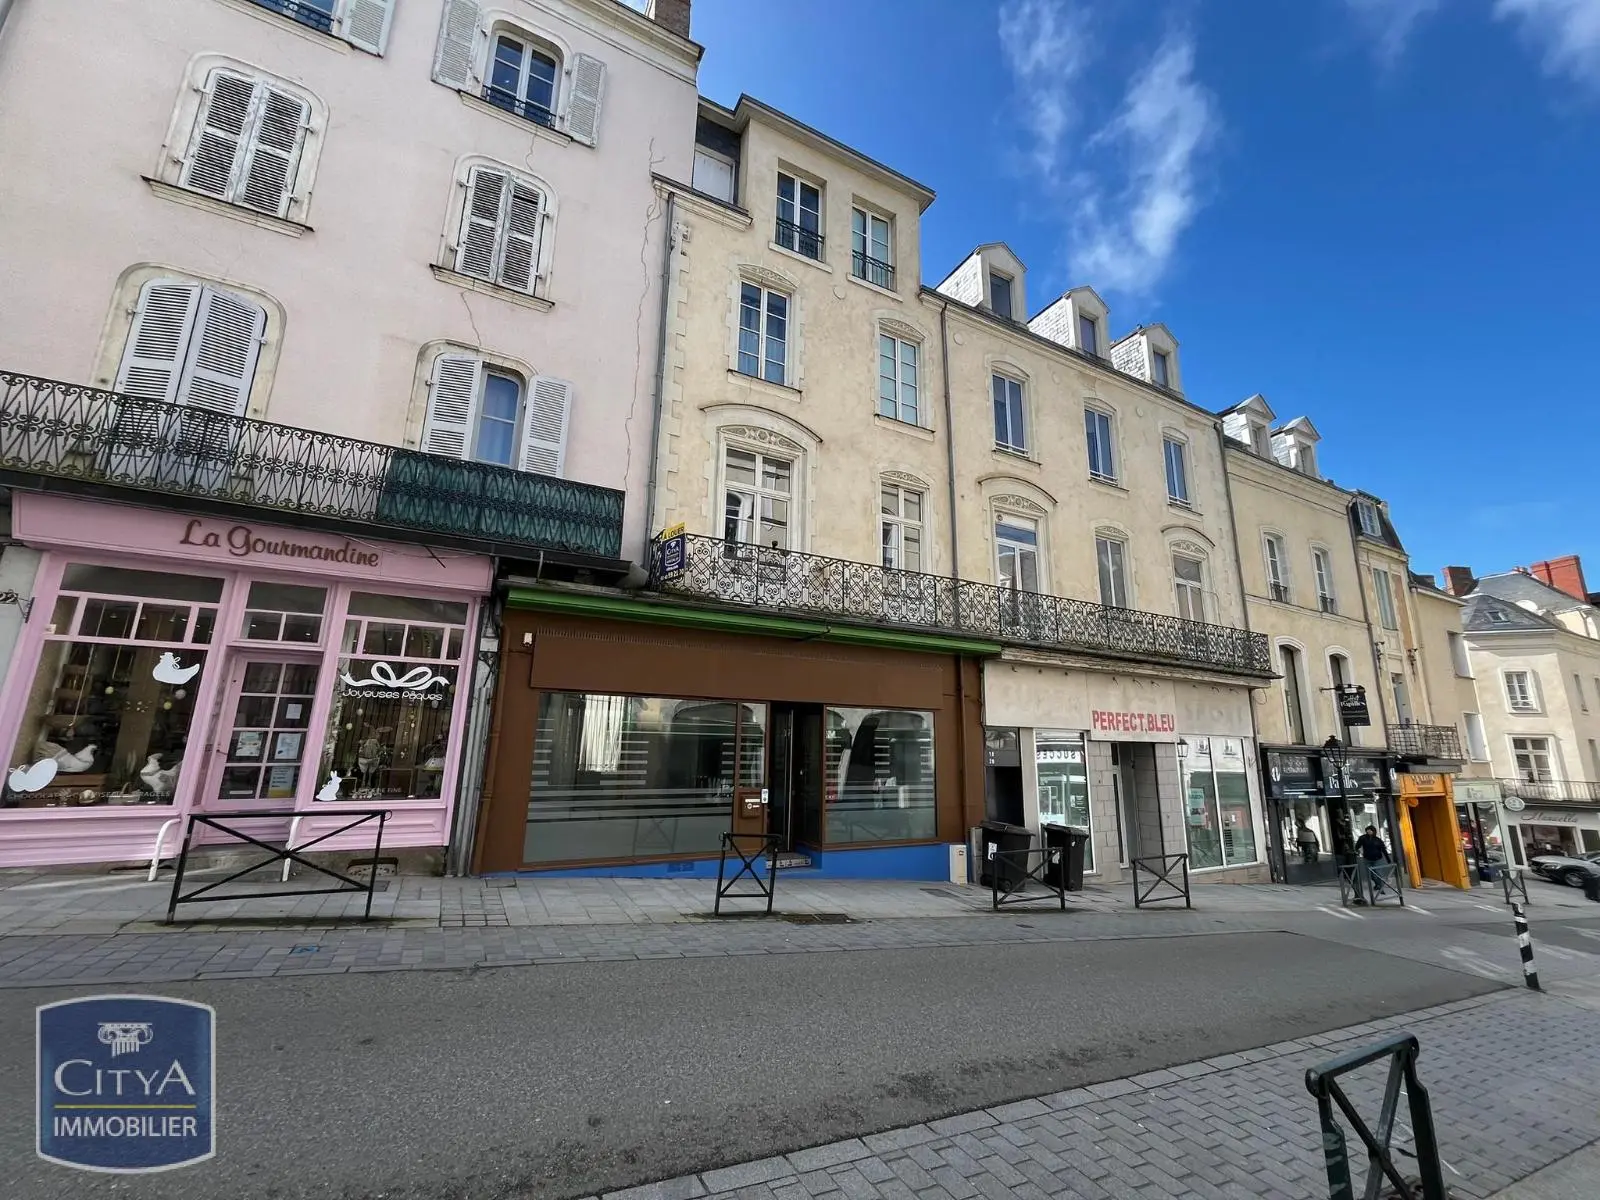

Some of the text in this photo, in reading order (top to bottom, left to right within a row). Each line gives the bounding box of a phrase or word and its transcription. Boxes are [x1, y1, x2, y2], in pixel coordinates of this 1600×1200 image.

[180, 519, 379, 567] La Gourmandine
[1328, 776, 1359, 789] Pailles
